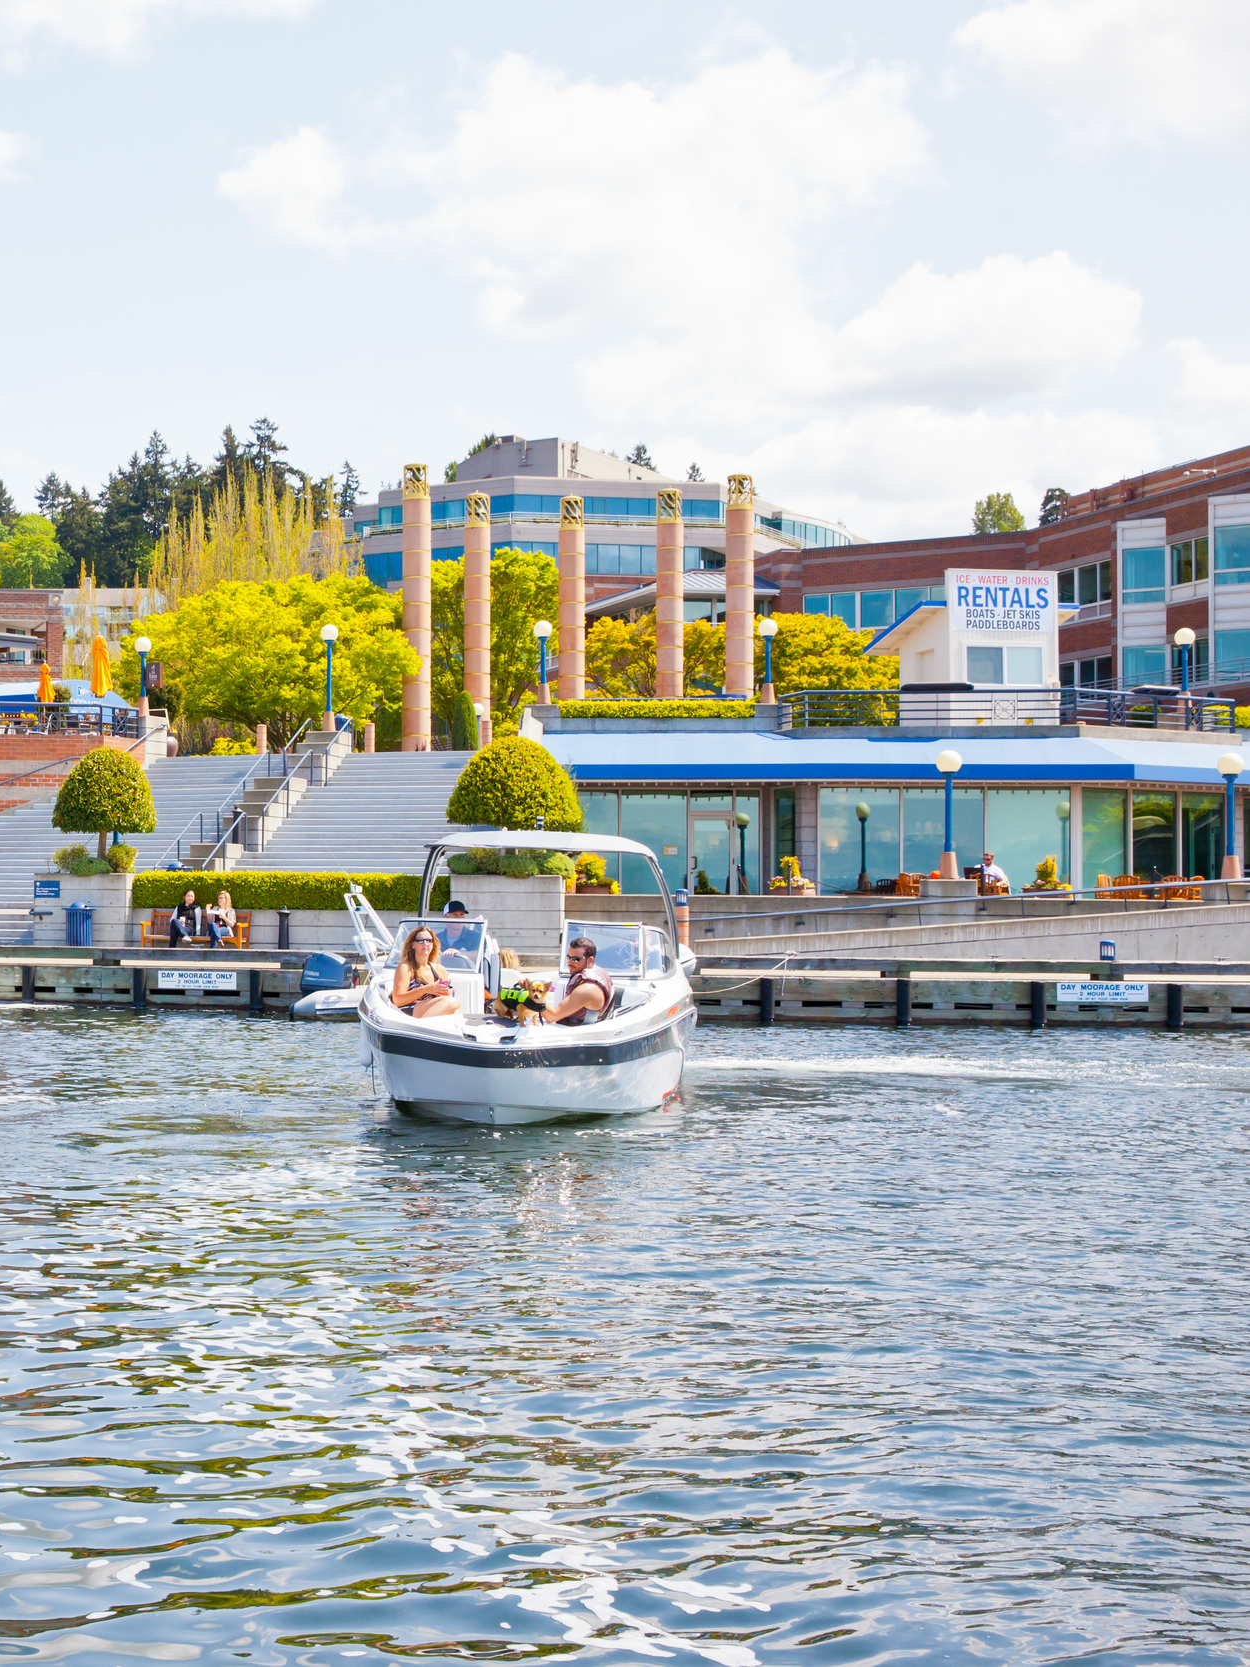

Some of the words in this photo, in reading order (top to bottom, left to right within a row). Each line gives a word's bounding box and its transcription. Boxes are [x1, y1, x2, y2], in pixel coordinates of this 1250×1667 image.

[956, 574, 971, 584] ICE
[978, 575, 1008, 585] WATER
[1016, 576, 1049, 586] DRINKS
[957, 585, 1049, 609] RENTALS
[966, 609, 995, 619] BOATS
[1002, 610, 1016, 619] JET
[1019, 610, 1041, 620] SKIS
[966, 619, 1041, 631] PADDLEBOARDS
[178, 972, 212, 980] MOORAGE
